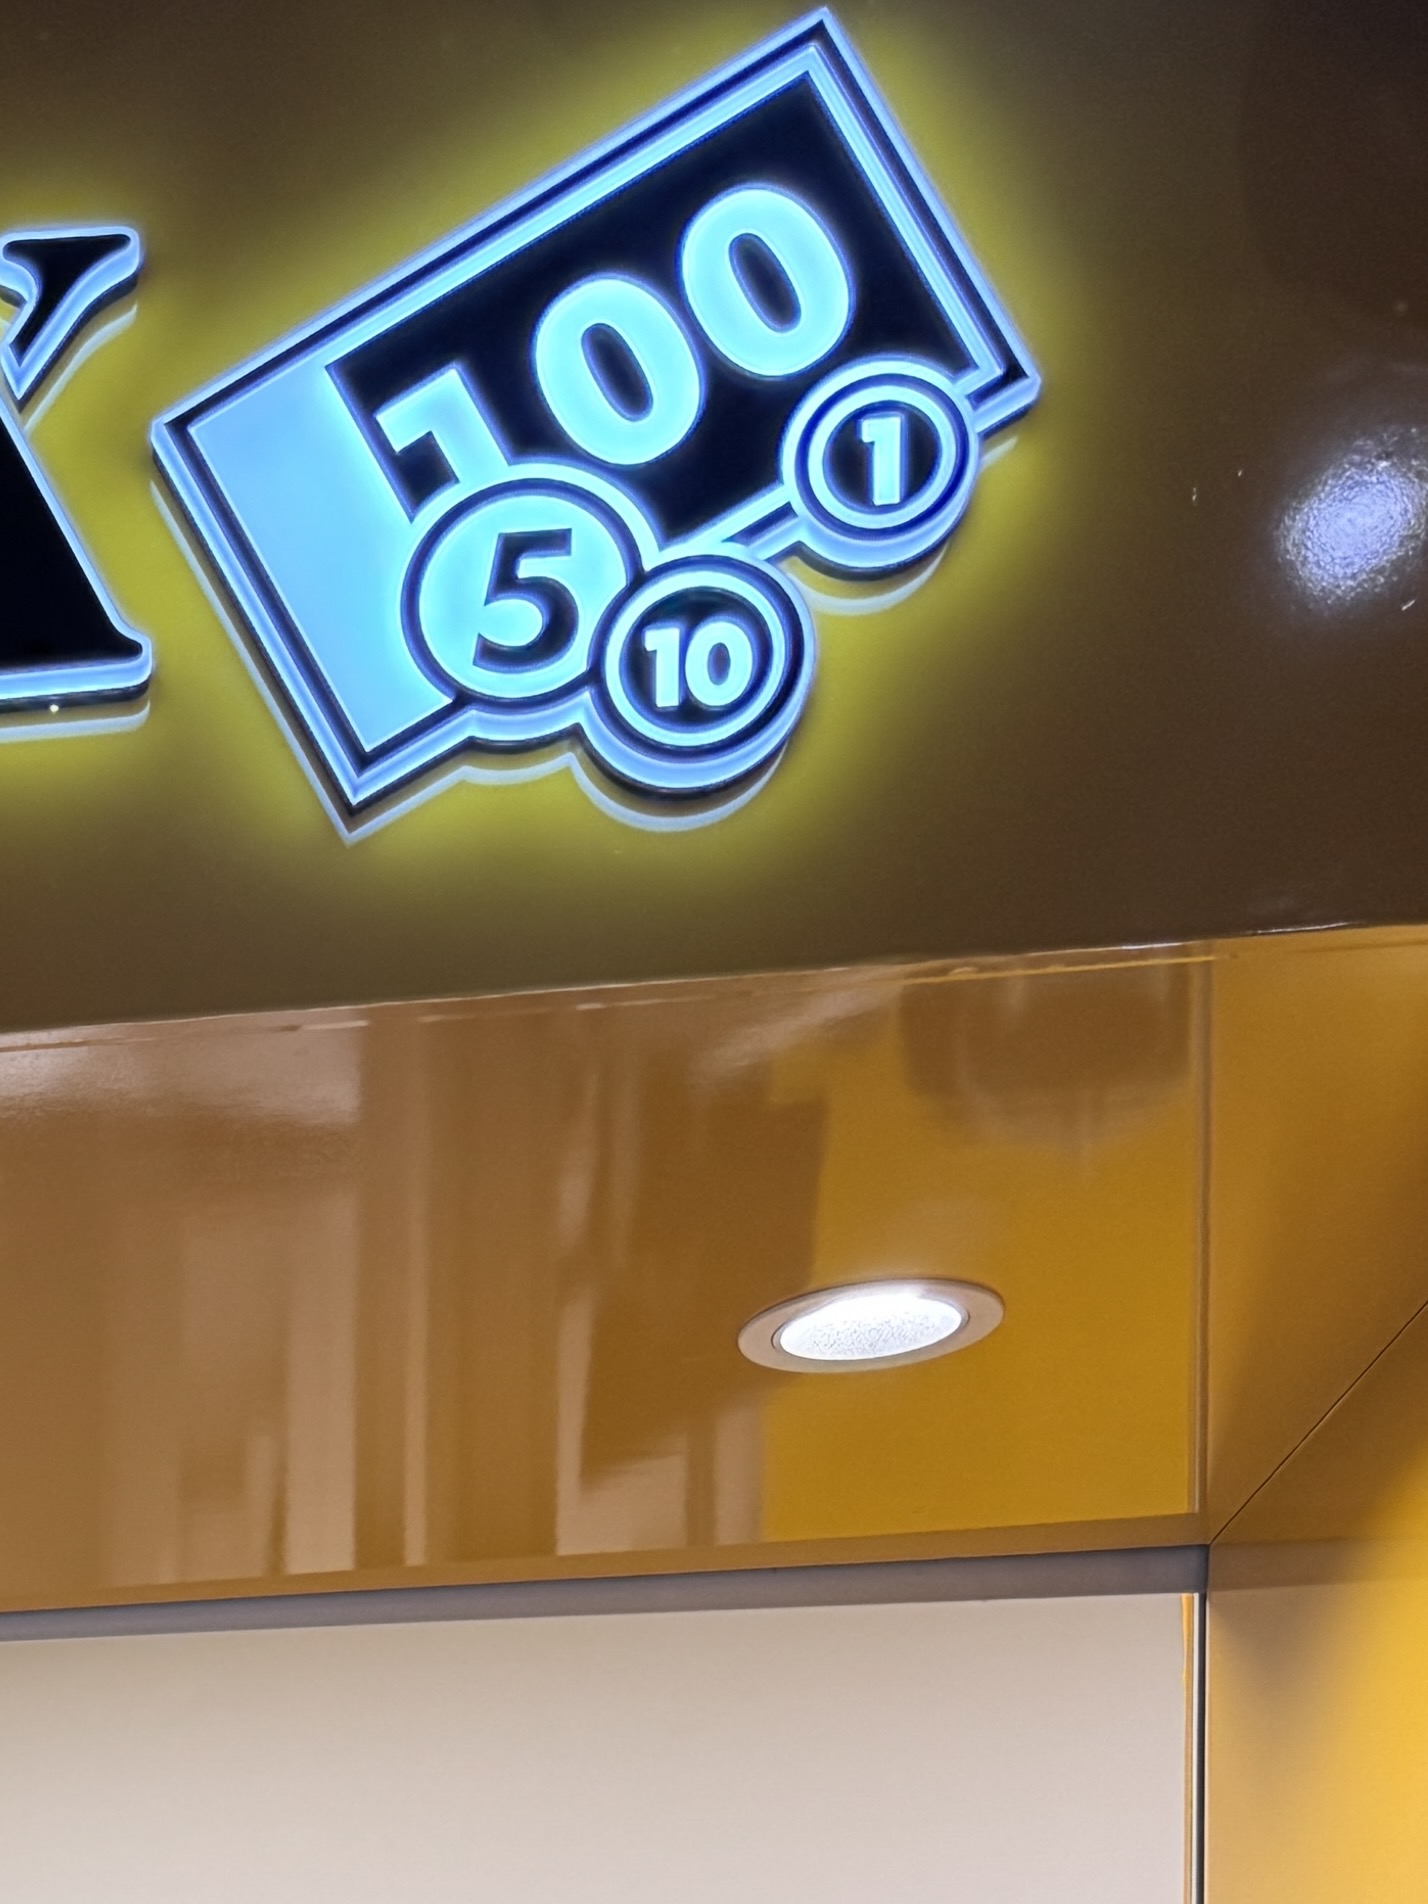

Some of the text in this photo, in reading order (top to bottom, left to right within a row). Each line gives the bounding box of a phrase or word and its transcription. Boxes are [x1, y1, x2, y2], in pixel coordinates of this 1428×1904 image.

[370, 185, 853, 484] 100
[857, 411, 905, 508] 1
[472, 527, 581, 672] 5
[642, 617, 752, 710] 10
